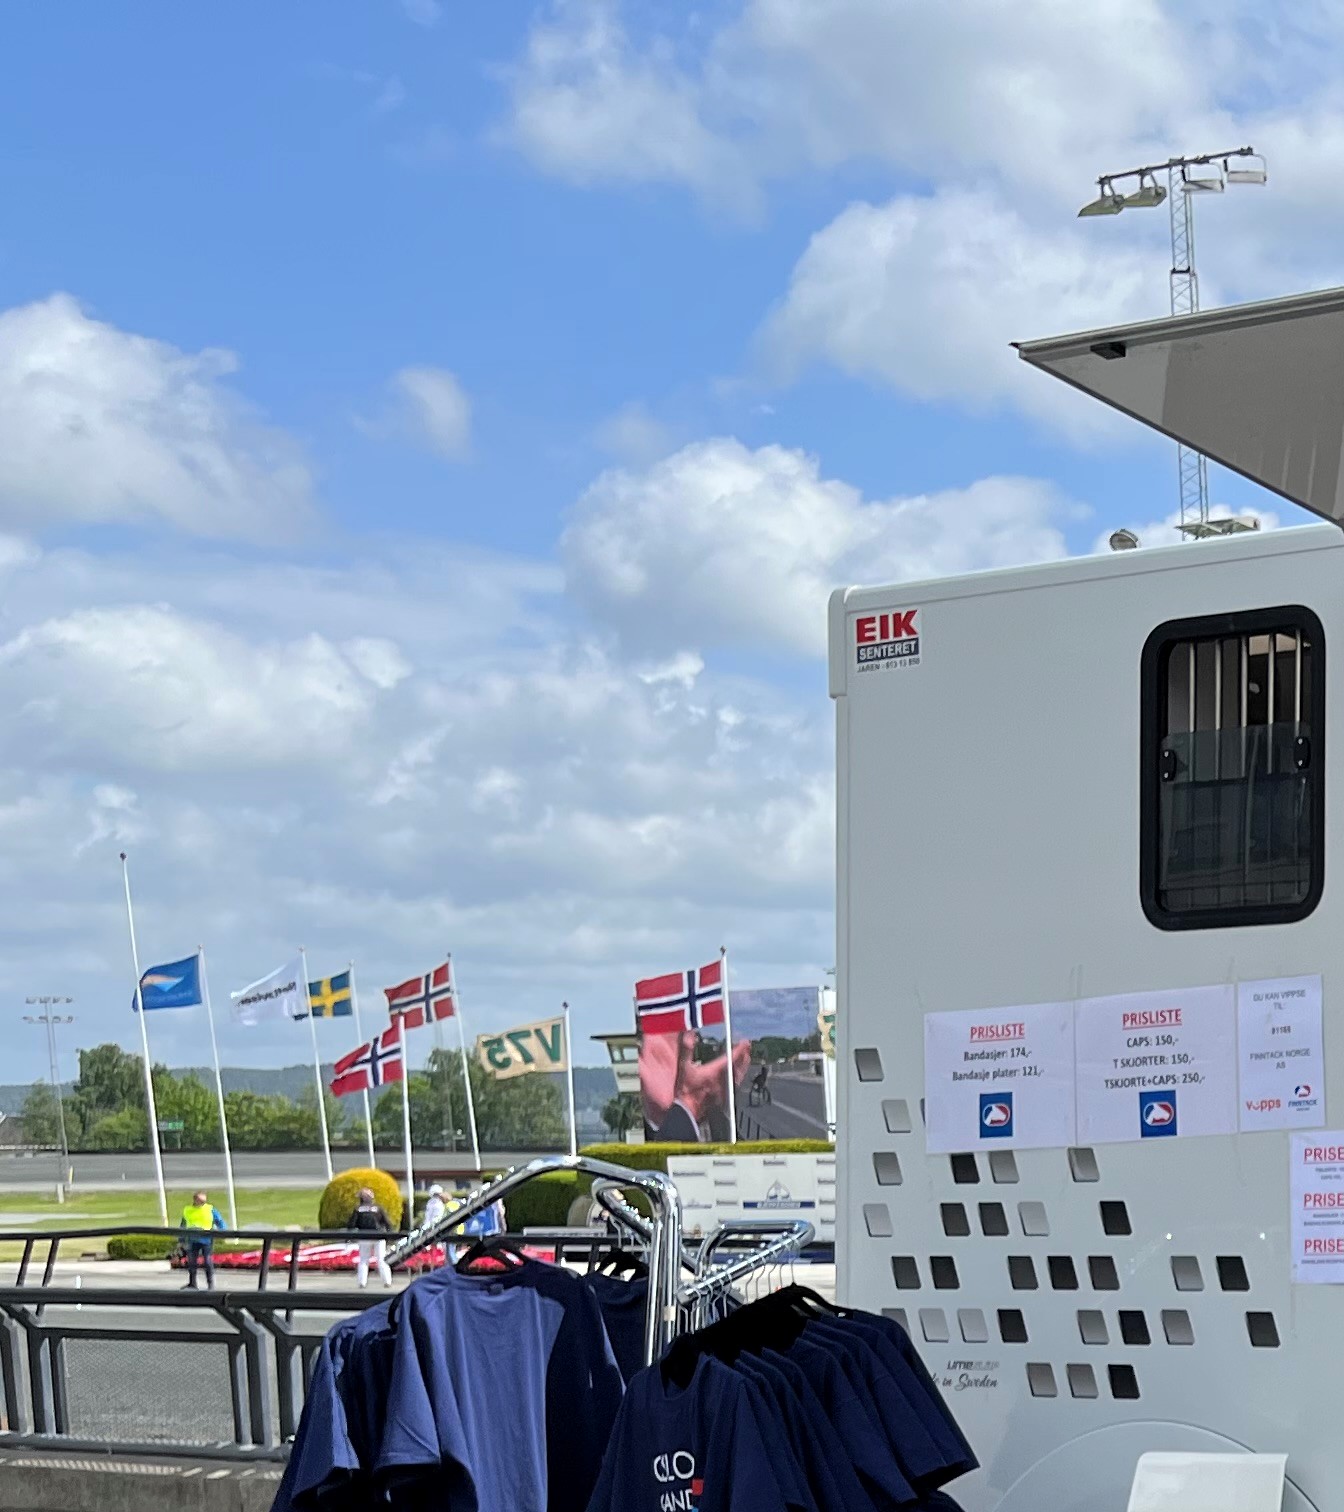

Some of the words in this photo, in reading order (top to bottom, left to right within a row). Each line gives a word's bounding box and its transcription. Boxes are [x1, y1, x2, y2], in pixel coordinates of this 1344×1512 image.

[857, 609, 918, 643] EIK
[859, 640, 917, 661] SENTERET
[1122, 1008, 1182, 1028] PRISLISTE
[970, 1022, 1025, 1040] PRISLISTE
[1127, 1037, 1153, 1048] CAPS:
[1155, 1035, 1180, 1047] 150,-
[964, 1049, 1008, 1062] Bandasjer:
[952, 1070, 990, 1082] Bandasje
[954, 1372, 998, 1392] Sweden
